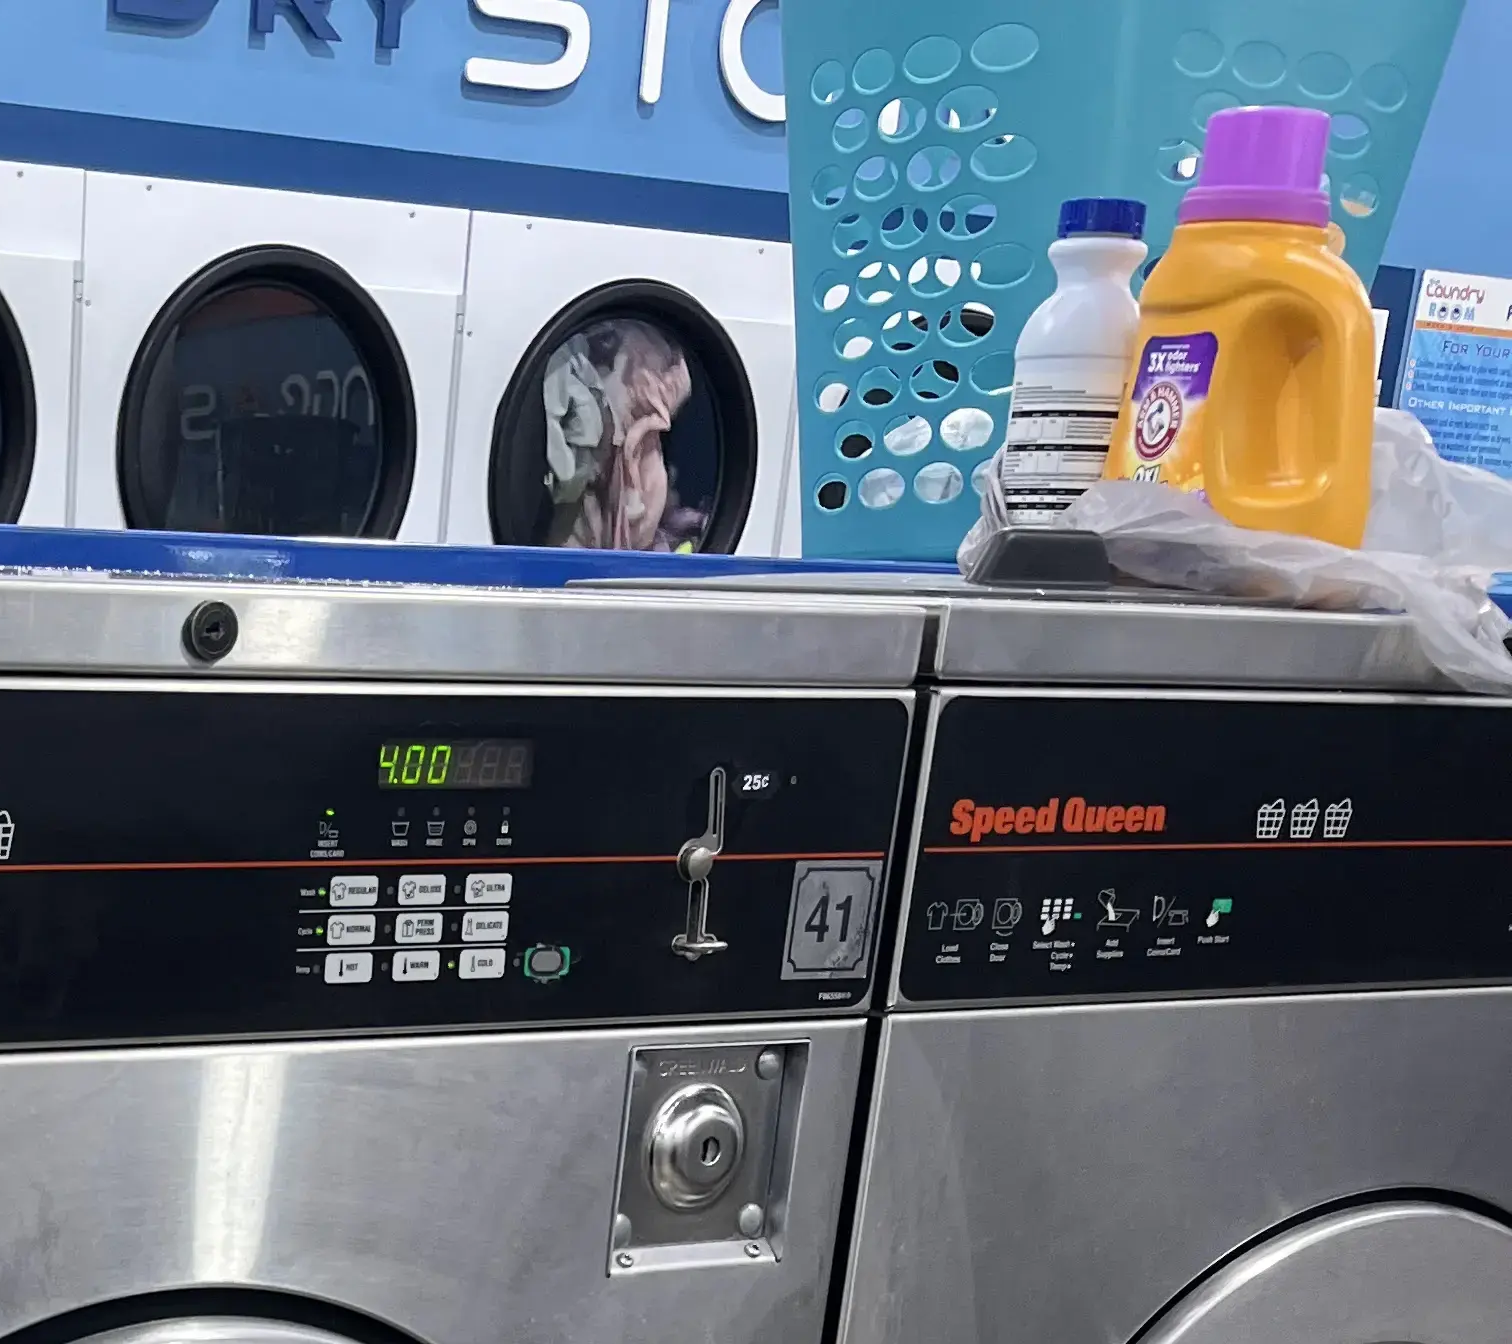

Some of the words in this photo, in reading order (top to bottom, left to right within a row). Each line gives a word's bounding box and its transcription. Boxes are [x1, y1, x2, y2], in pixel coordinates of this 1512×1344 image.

[1426, 284, 1486, 304] Laundry
[1442, 340, 1469, 355] FOR
[1147, 352, 1167, 373] 3X
[1167, 350, 1189, 361] odor
[1408, 396, 1445, 409] OTHER
[1449, 400, 1507, 415] IMPORTANT
[379, 744, 452, 785] 4.00
[742, 773, 771, 791] 25¢
[949, 797, 1060, 843] Speed
[1062, 797, 1167, 833] Queen
[804, 894, 853, 943] 41
